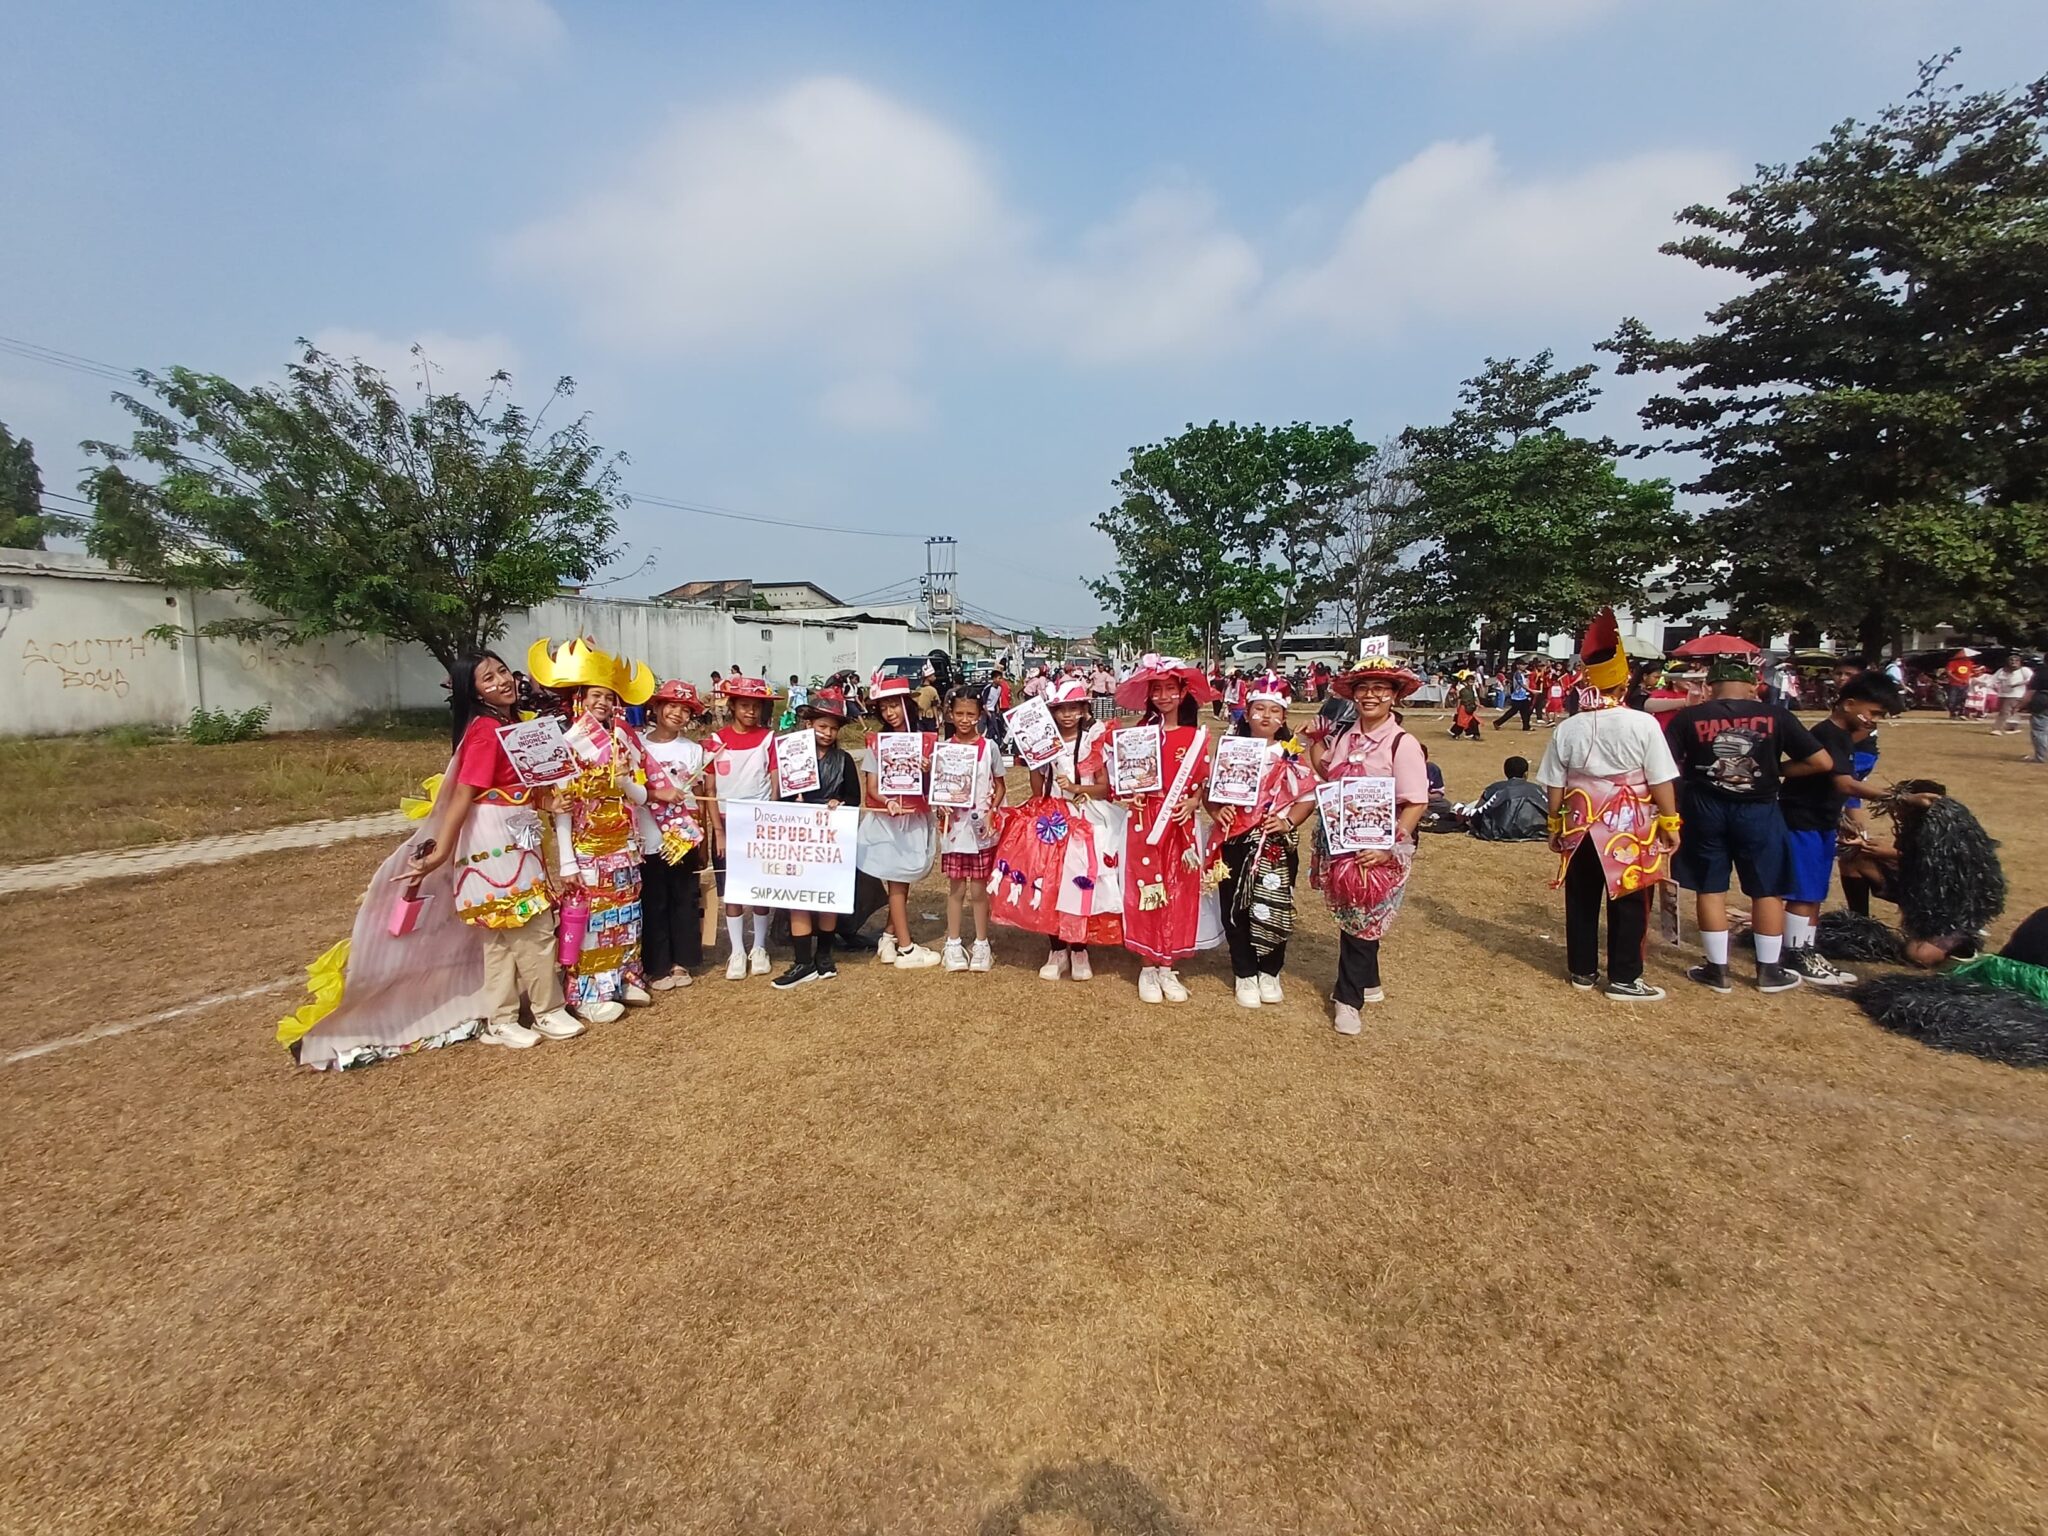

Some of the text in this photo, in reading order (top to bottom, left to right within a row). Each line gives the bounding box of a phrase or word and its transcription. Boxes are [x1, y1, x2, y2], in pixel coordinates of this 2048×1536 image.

[518, 734, 553, 748] INDONESIA
[756, 825, 838, 844] REPUBLIK
[747, 842, 843, 864] INDONESIA
